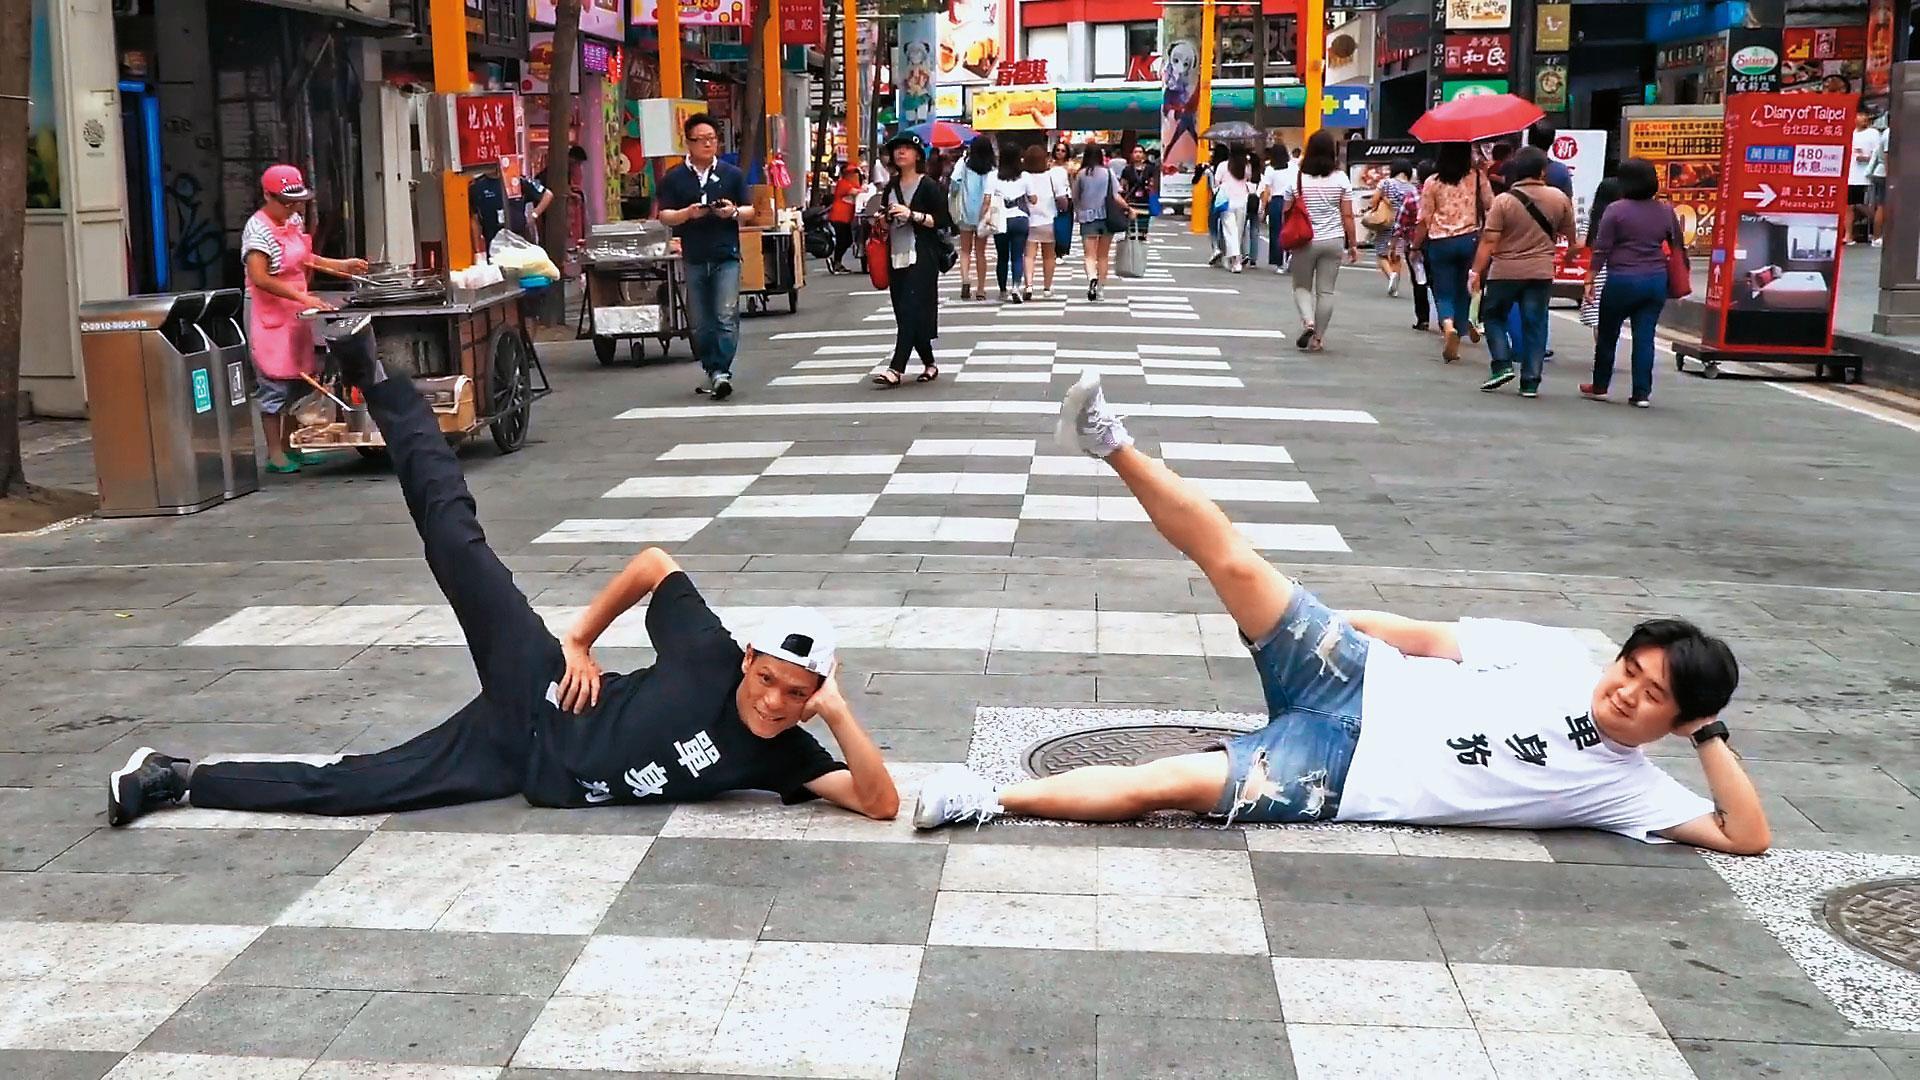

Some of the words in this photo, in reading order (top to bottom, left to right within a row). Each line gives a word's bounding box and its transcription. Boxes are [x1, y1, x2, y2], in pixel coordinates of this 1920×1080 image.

[1462, 47, 1507, 66] 和民
[1764, 105, 1797, 123] Diary
[1797, 105, 1812, 120] of
[1813, 105, 1846, 123] Taipei
[1389, 145, 1416, 154] PLAZA
[1798, 148, 1823, 160] 480
[1796, 161, 1820, 173] 休息
[1780, 199, 1807, 208] Please
[1821, 200, 1836, 209] 12F
